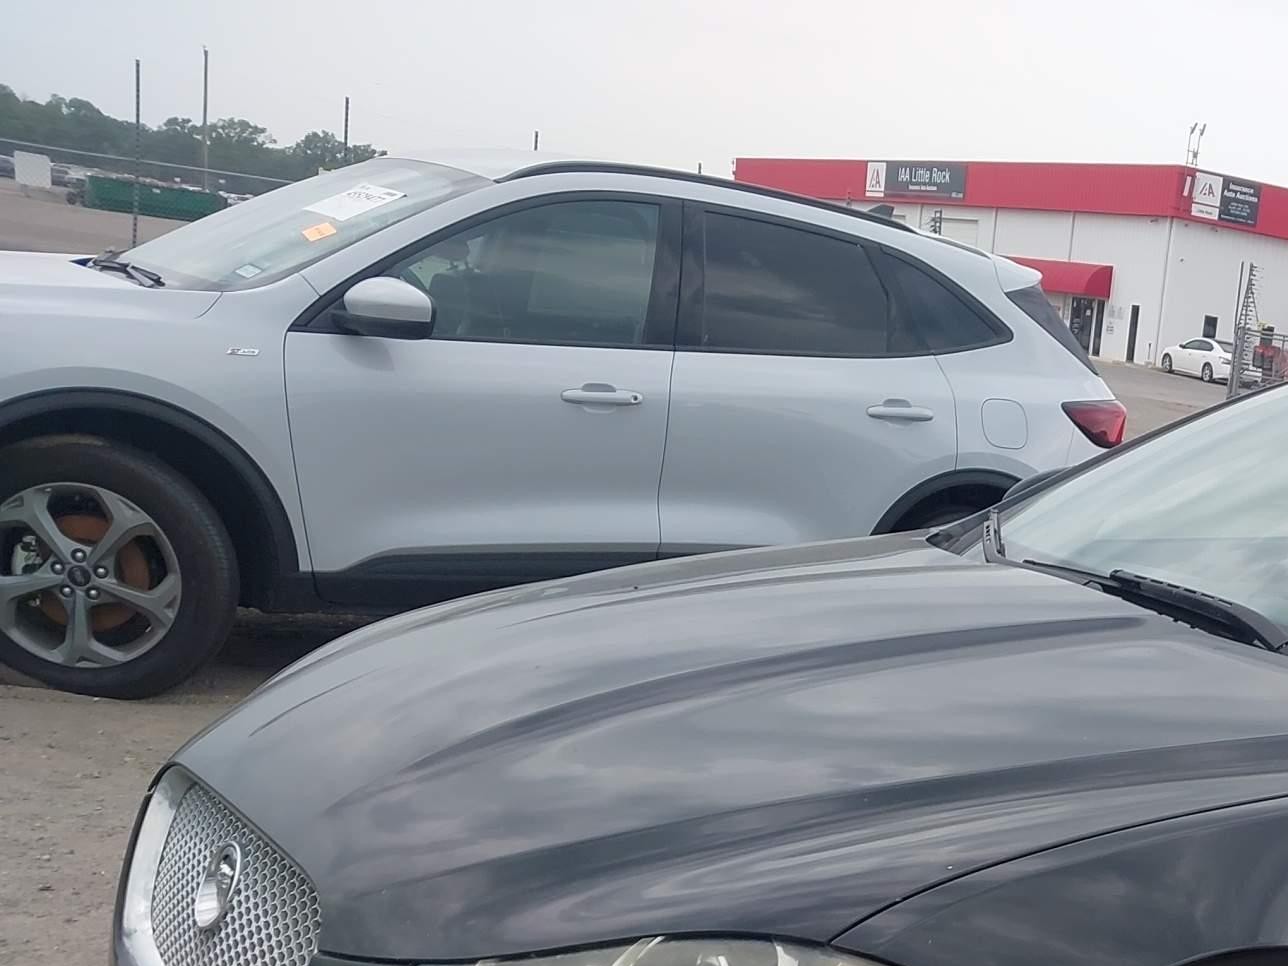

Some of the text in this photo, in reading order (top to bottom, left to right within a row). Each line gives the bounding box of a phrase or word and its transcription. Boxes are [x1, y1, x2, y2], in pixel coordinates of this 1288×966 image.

[898, 167, 951, 183] IAA Little Rock
